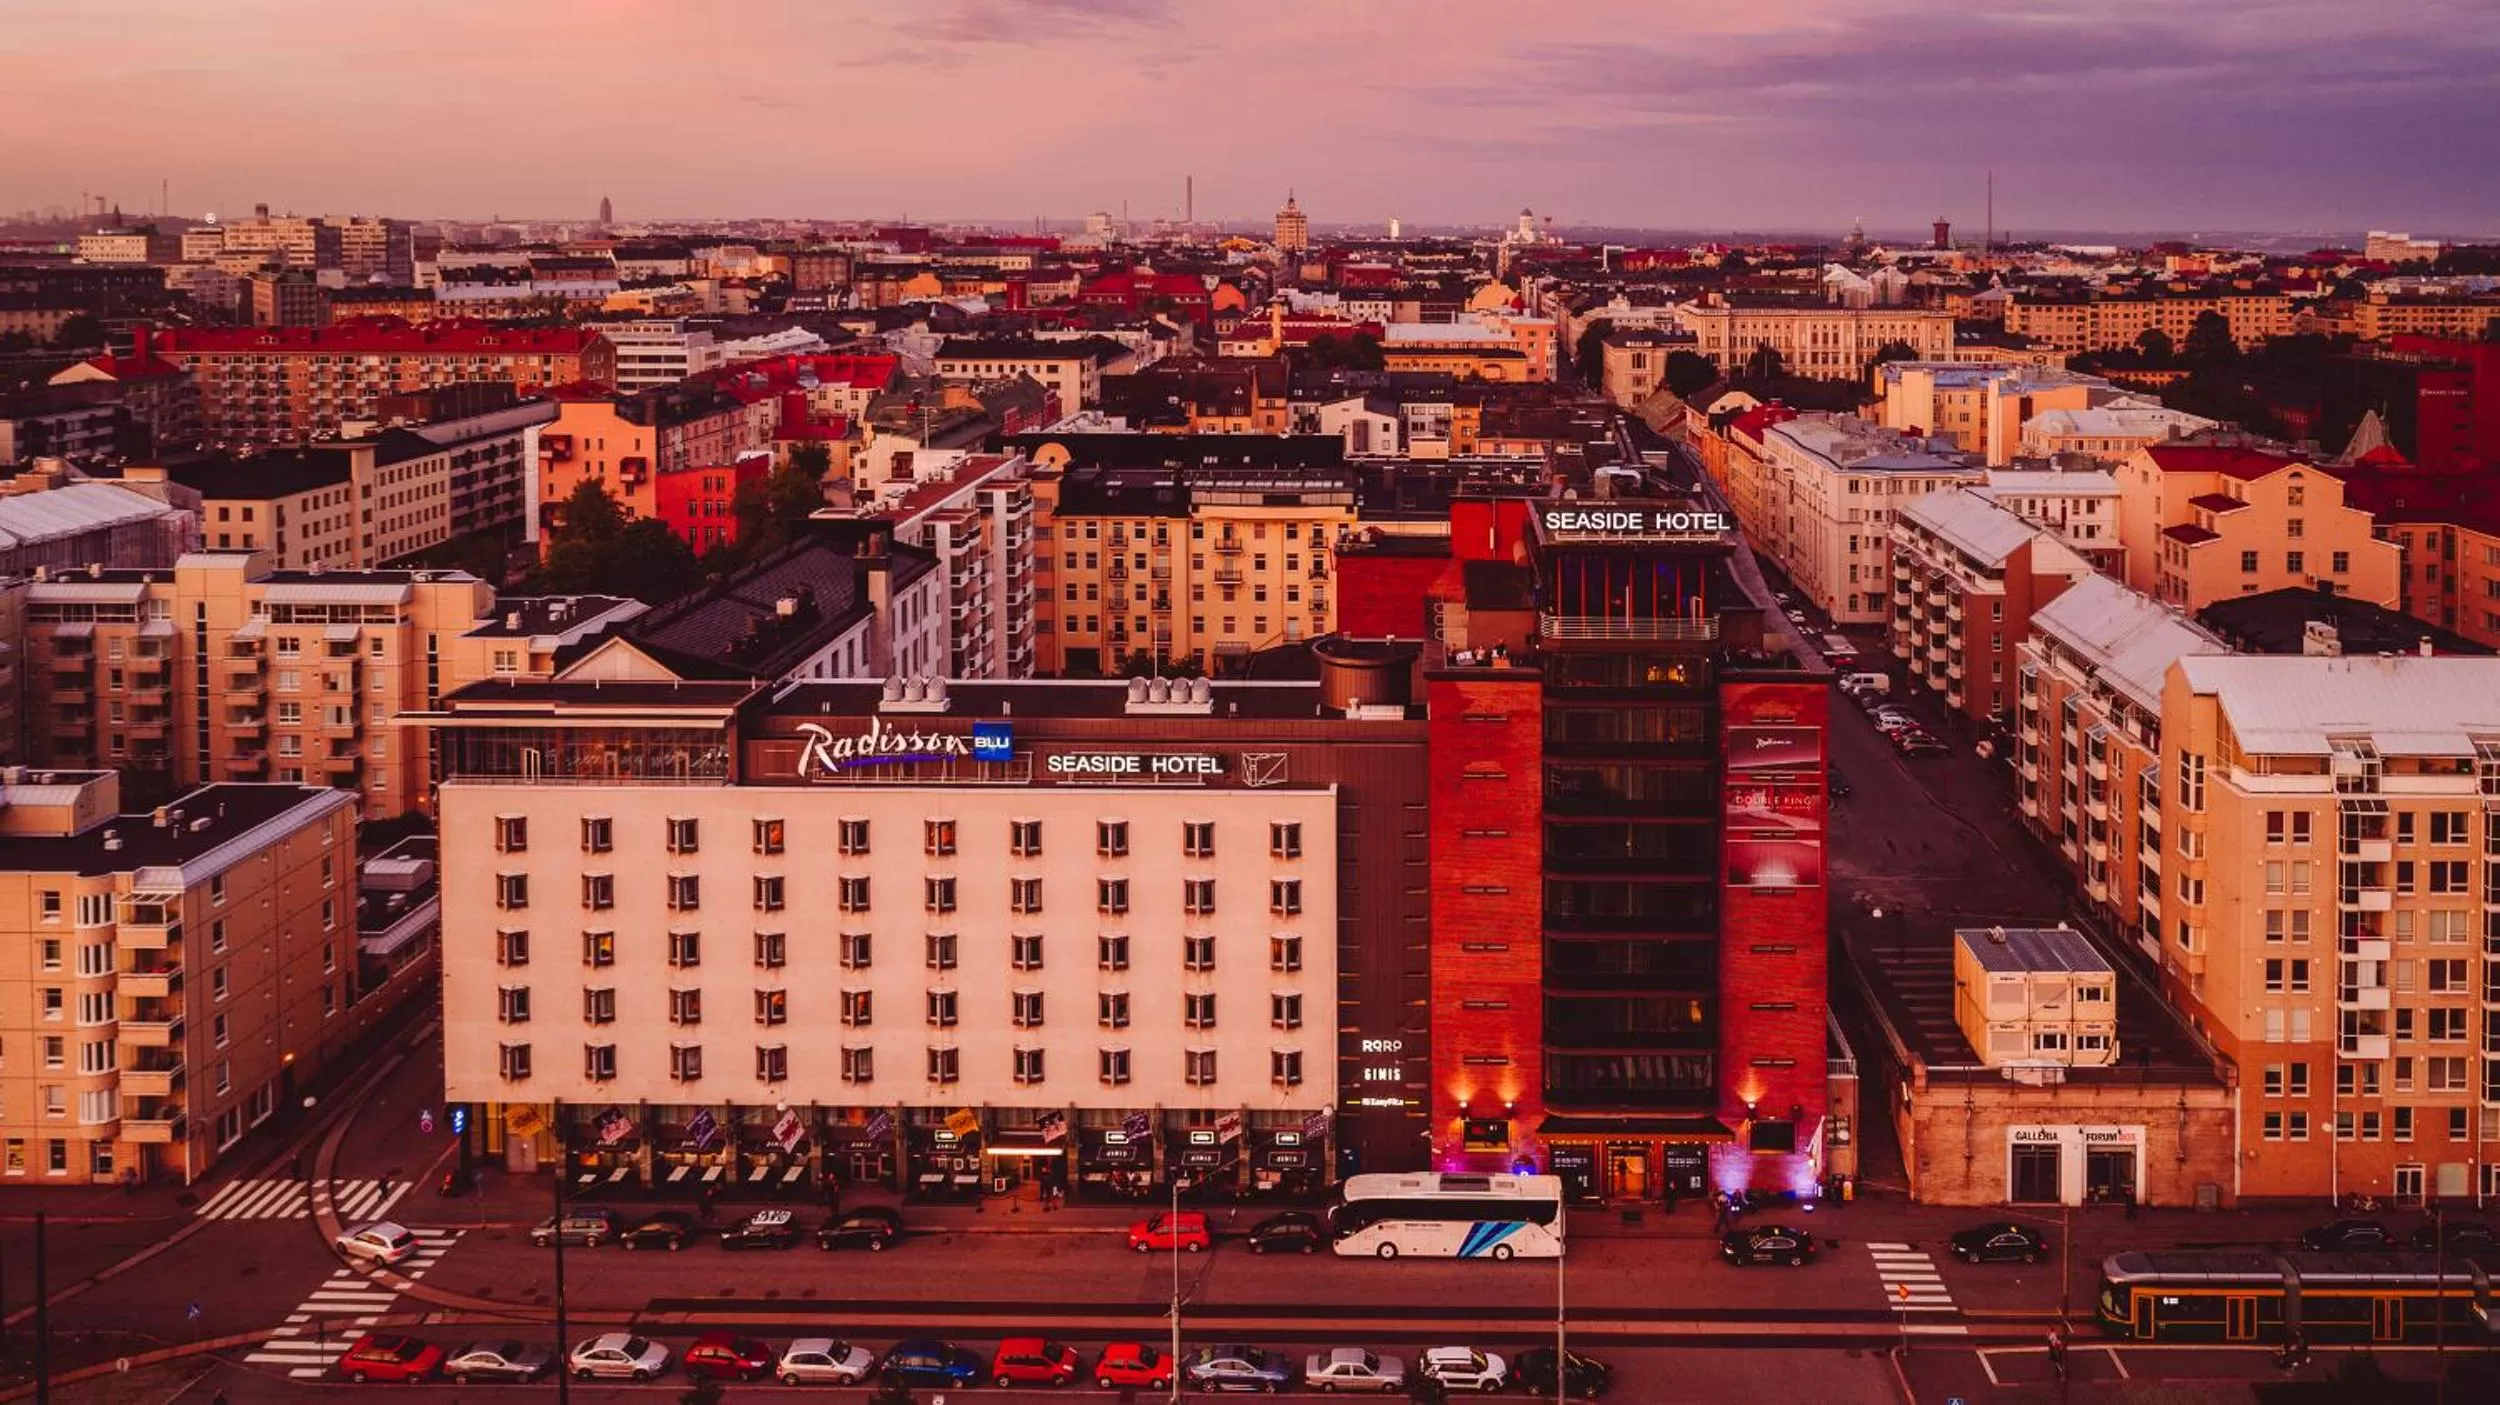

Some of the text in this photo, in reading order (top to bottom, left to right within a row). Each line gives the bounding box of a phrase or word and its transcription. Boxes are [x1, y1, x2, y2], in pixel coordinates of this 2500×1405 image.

[1545, 511, 1732, 531] SEASIDE HOTEL
[795, 716, 1011, 777] Radisson BLU
[1047, 754, 1225, 776] SEASIDE HOTEL
[1784, 795, 1813, 806] KING
[2014, 1131, 2059, 1141] GALLERIA
[2086, 1132, 2118, 1142] FORUM
